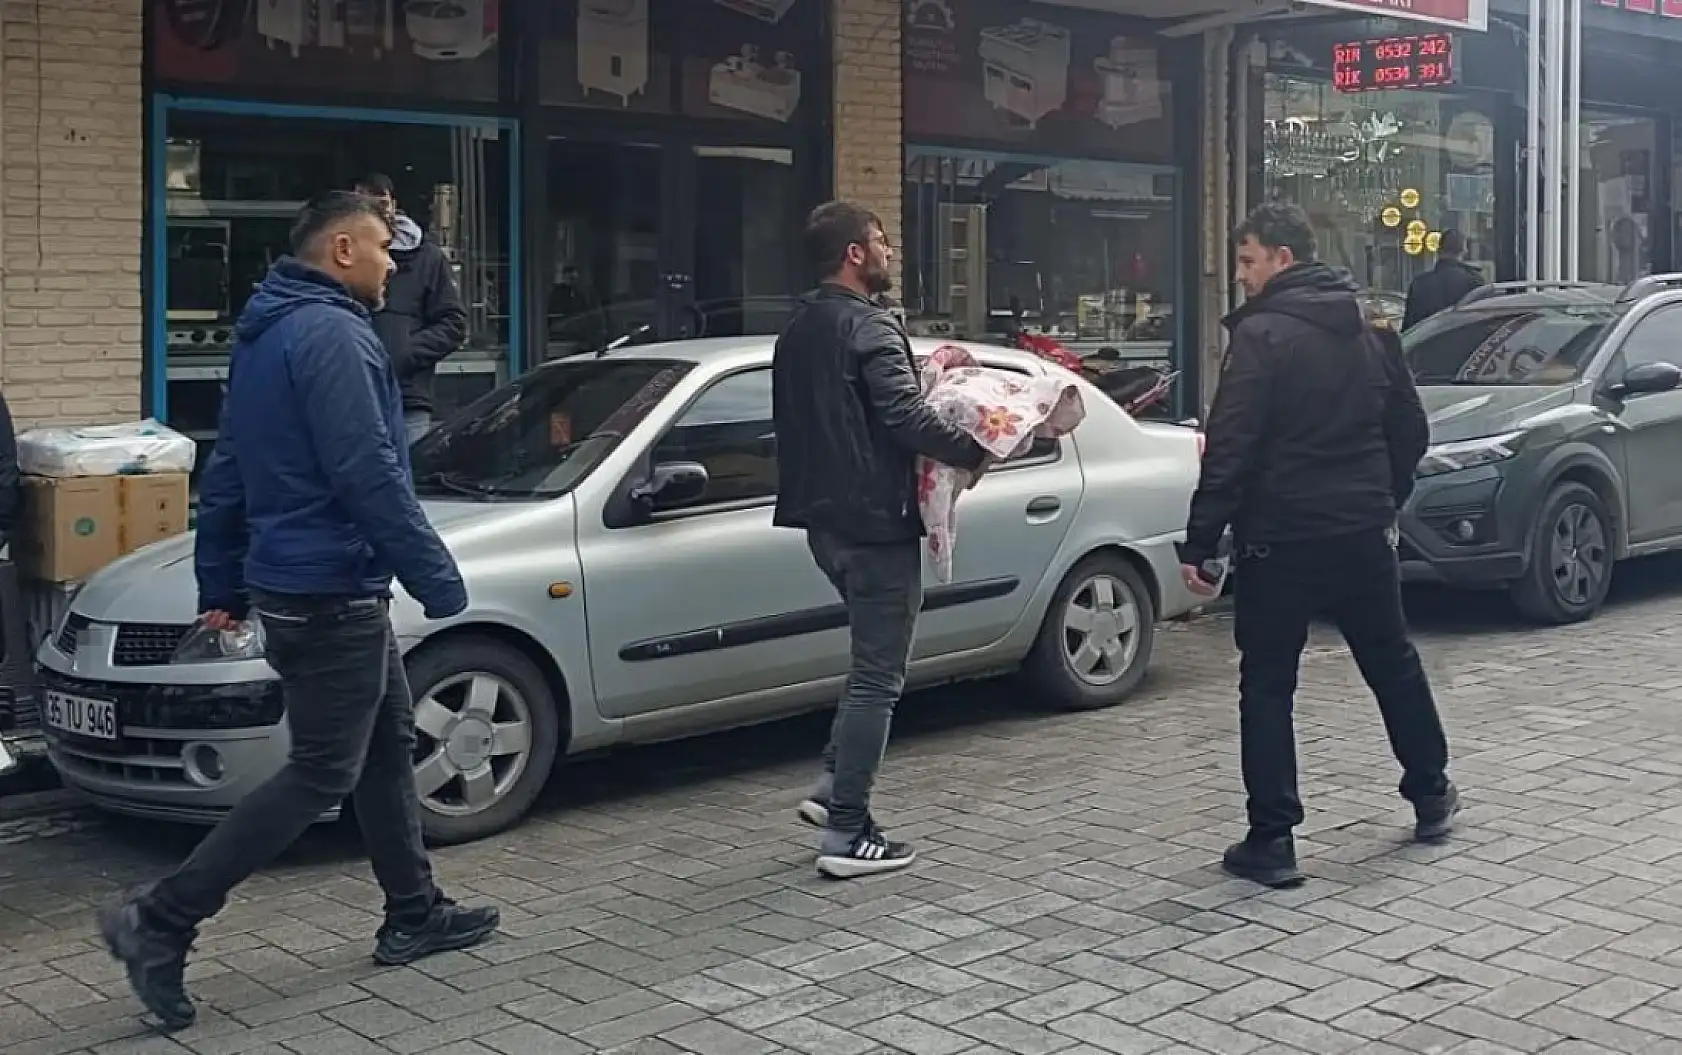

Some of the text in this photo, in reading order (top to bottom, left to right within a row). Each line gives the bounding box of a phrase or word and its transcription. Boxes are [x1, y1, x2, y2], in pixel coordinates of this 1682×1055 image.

[1375, 43, 1411, 60] 0532
[1419, 40, 1446, 55] 242
[1375, 66, 1409, 83] 0534
[48, 694, 114, 735] 35 TU 946
